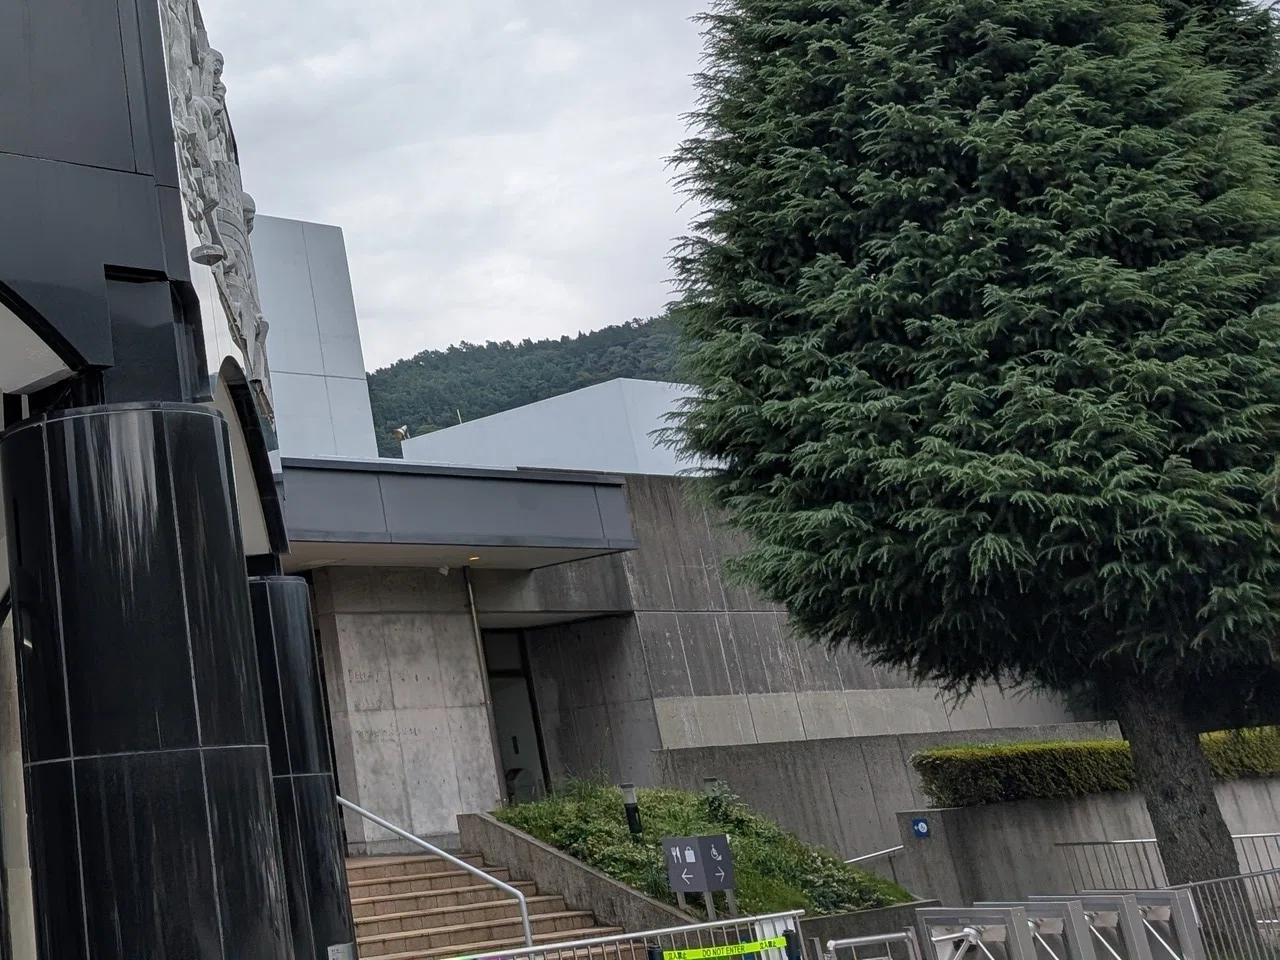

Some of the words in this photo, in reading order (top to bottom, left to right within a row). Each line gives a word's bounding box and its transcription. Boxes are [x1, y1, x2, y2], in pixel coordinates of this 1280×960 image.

[702, 949, 711, 958] DO
[712, 947, 725, 956] NOT
[726, 945, 745, 955] ENTER
